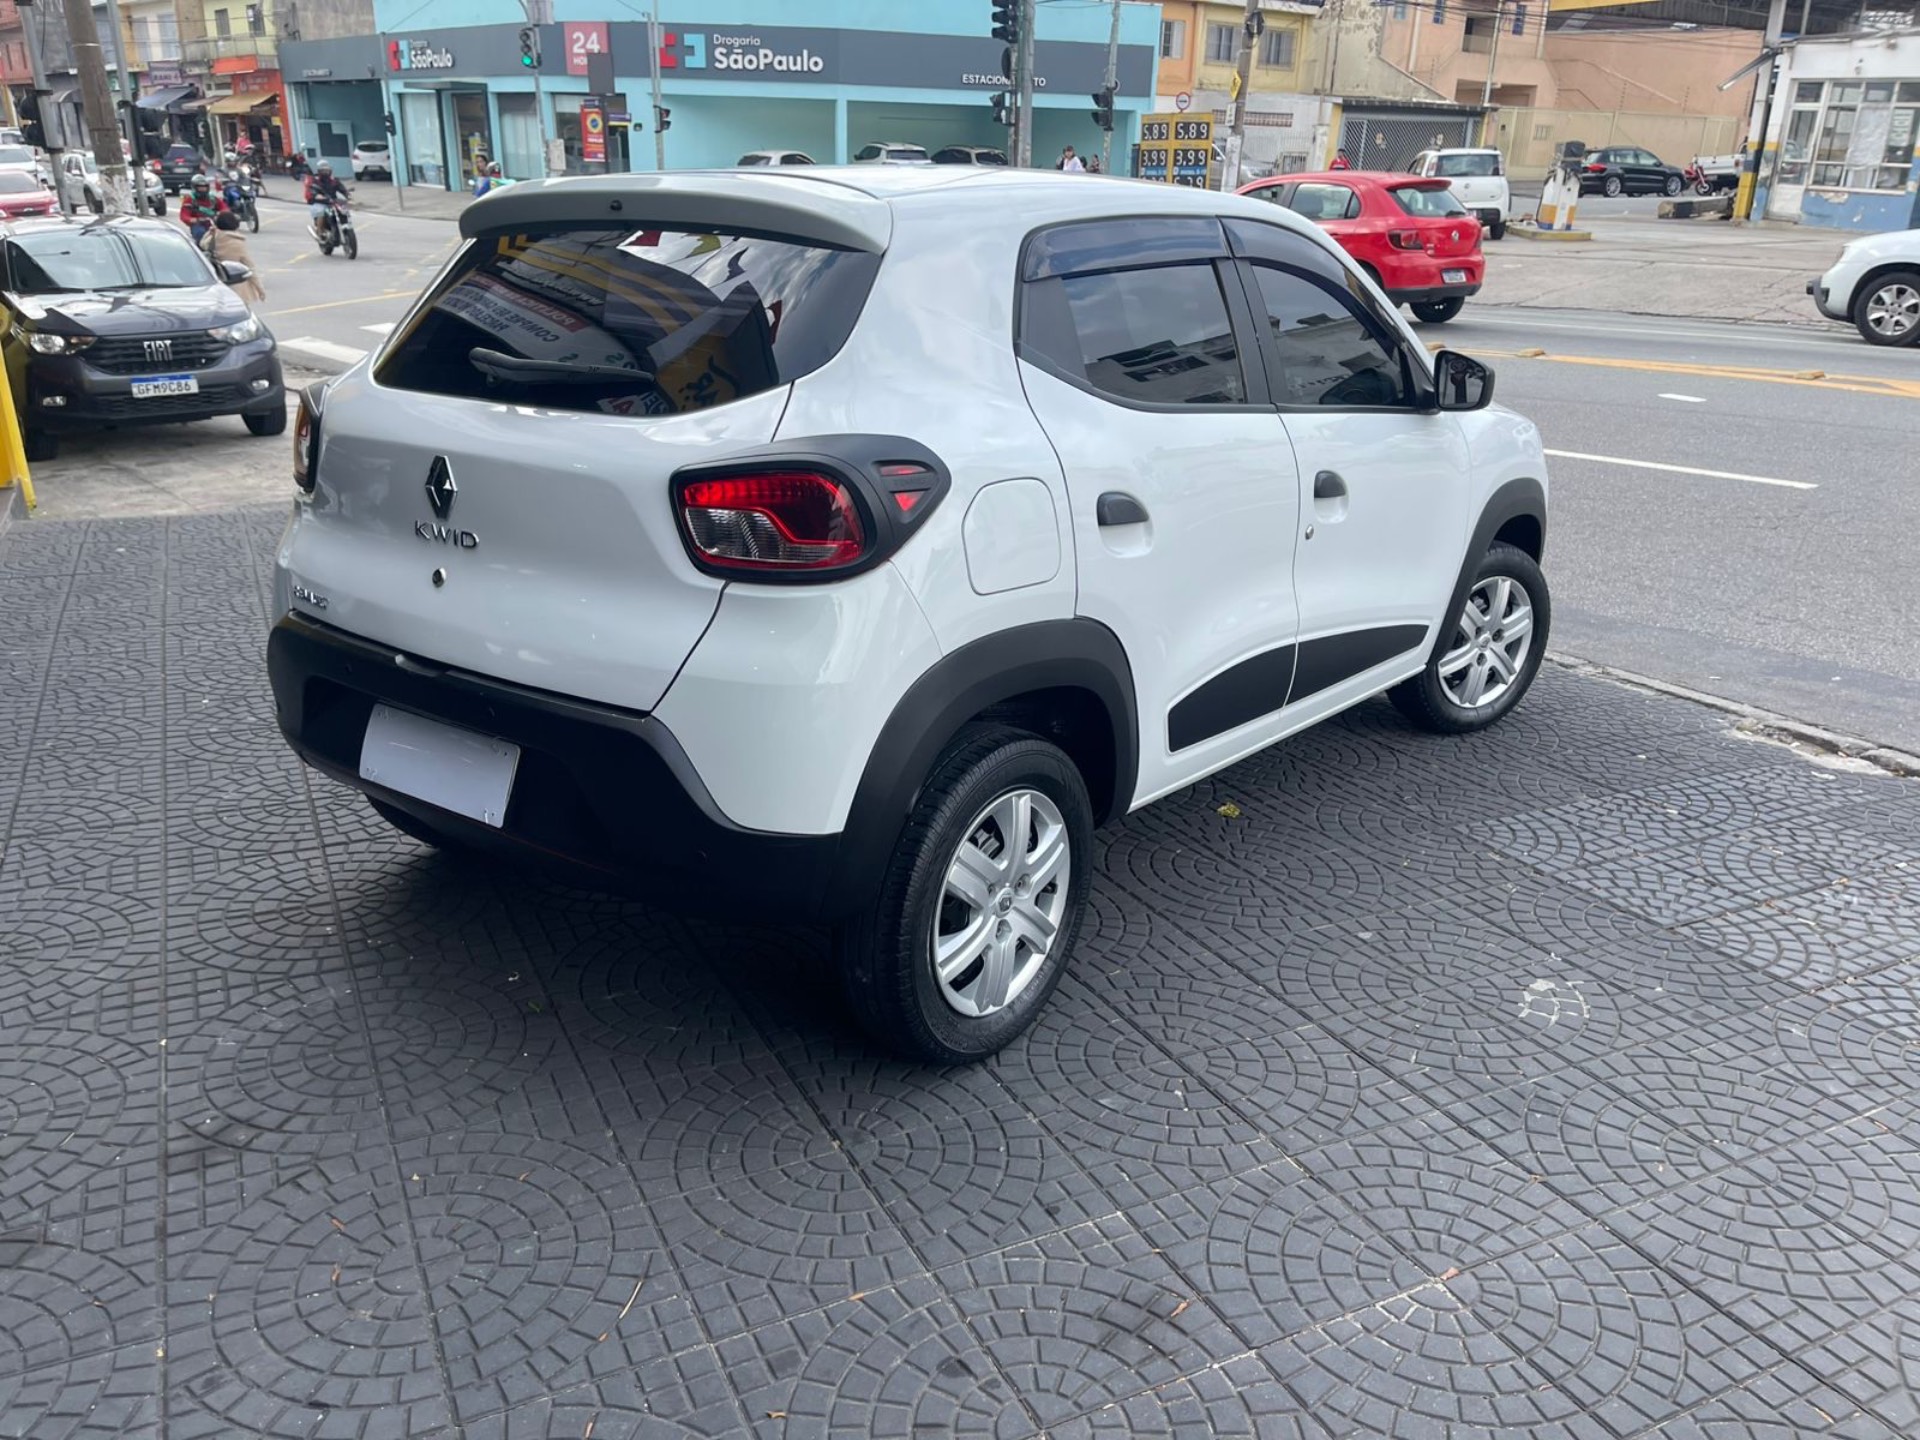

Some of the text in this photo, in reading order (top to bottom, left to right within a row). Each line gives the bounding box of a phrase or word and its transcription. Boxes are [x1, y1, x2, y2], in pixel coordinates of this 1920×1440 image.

[572, 31, 600, 54] 24
[713, 34, 761, 47] Drogaria
[714, 47, 824, 72] SãoPaulo
[1177, 123, 1208, 140] 5,89
[1176, 150, 1206, 166] 3,99
[143, 340, 173, 362] FIAT
[137, 382, 191, 396] GFM9C86
[415, 520, 480, 548] KWID
